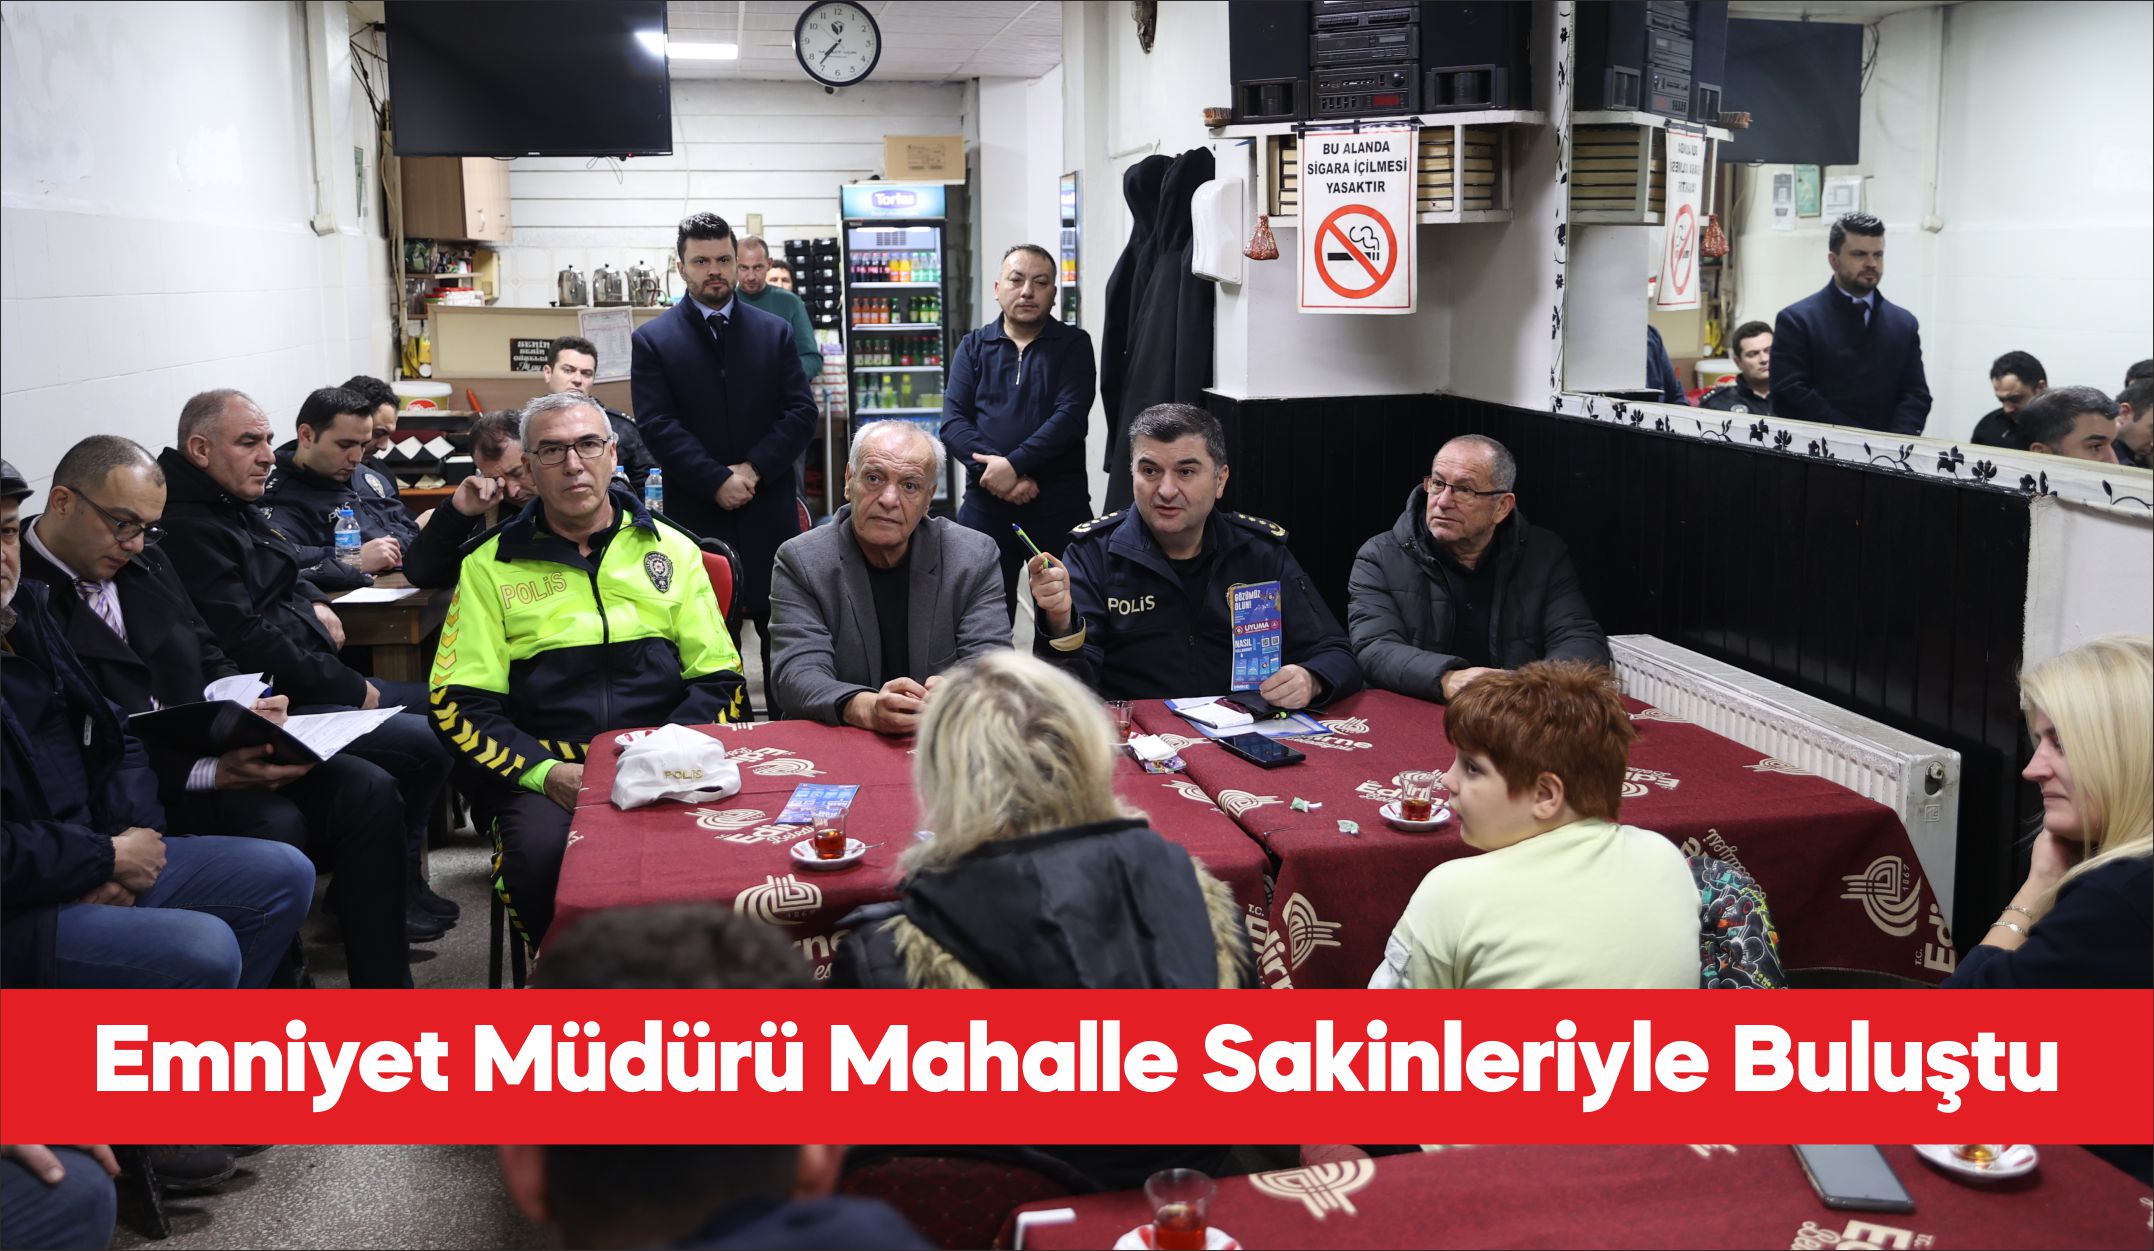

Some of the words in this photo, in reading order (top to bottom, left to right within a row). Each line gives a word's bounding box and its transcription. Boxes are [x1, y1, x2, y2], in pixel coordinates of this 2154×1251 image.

[1323, 143, 1339, 155] BU
[1343, 141, 1390, 154] ALANDA
[1307, 161, 1350, 175] SİGARA
[1354, 157, 1408, 176] İÇİLMESİ
[1326, 181, 1386, 193] YASAKTIR
[1244, 622, 1270, 632] UYUMA
[1248, 903, 1265, 917] T.C.
